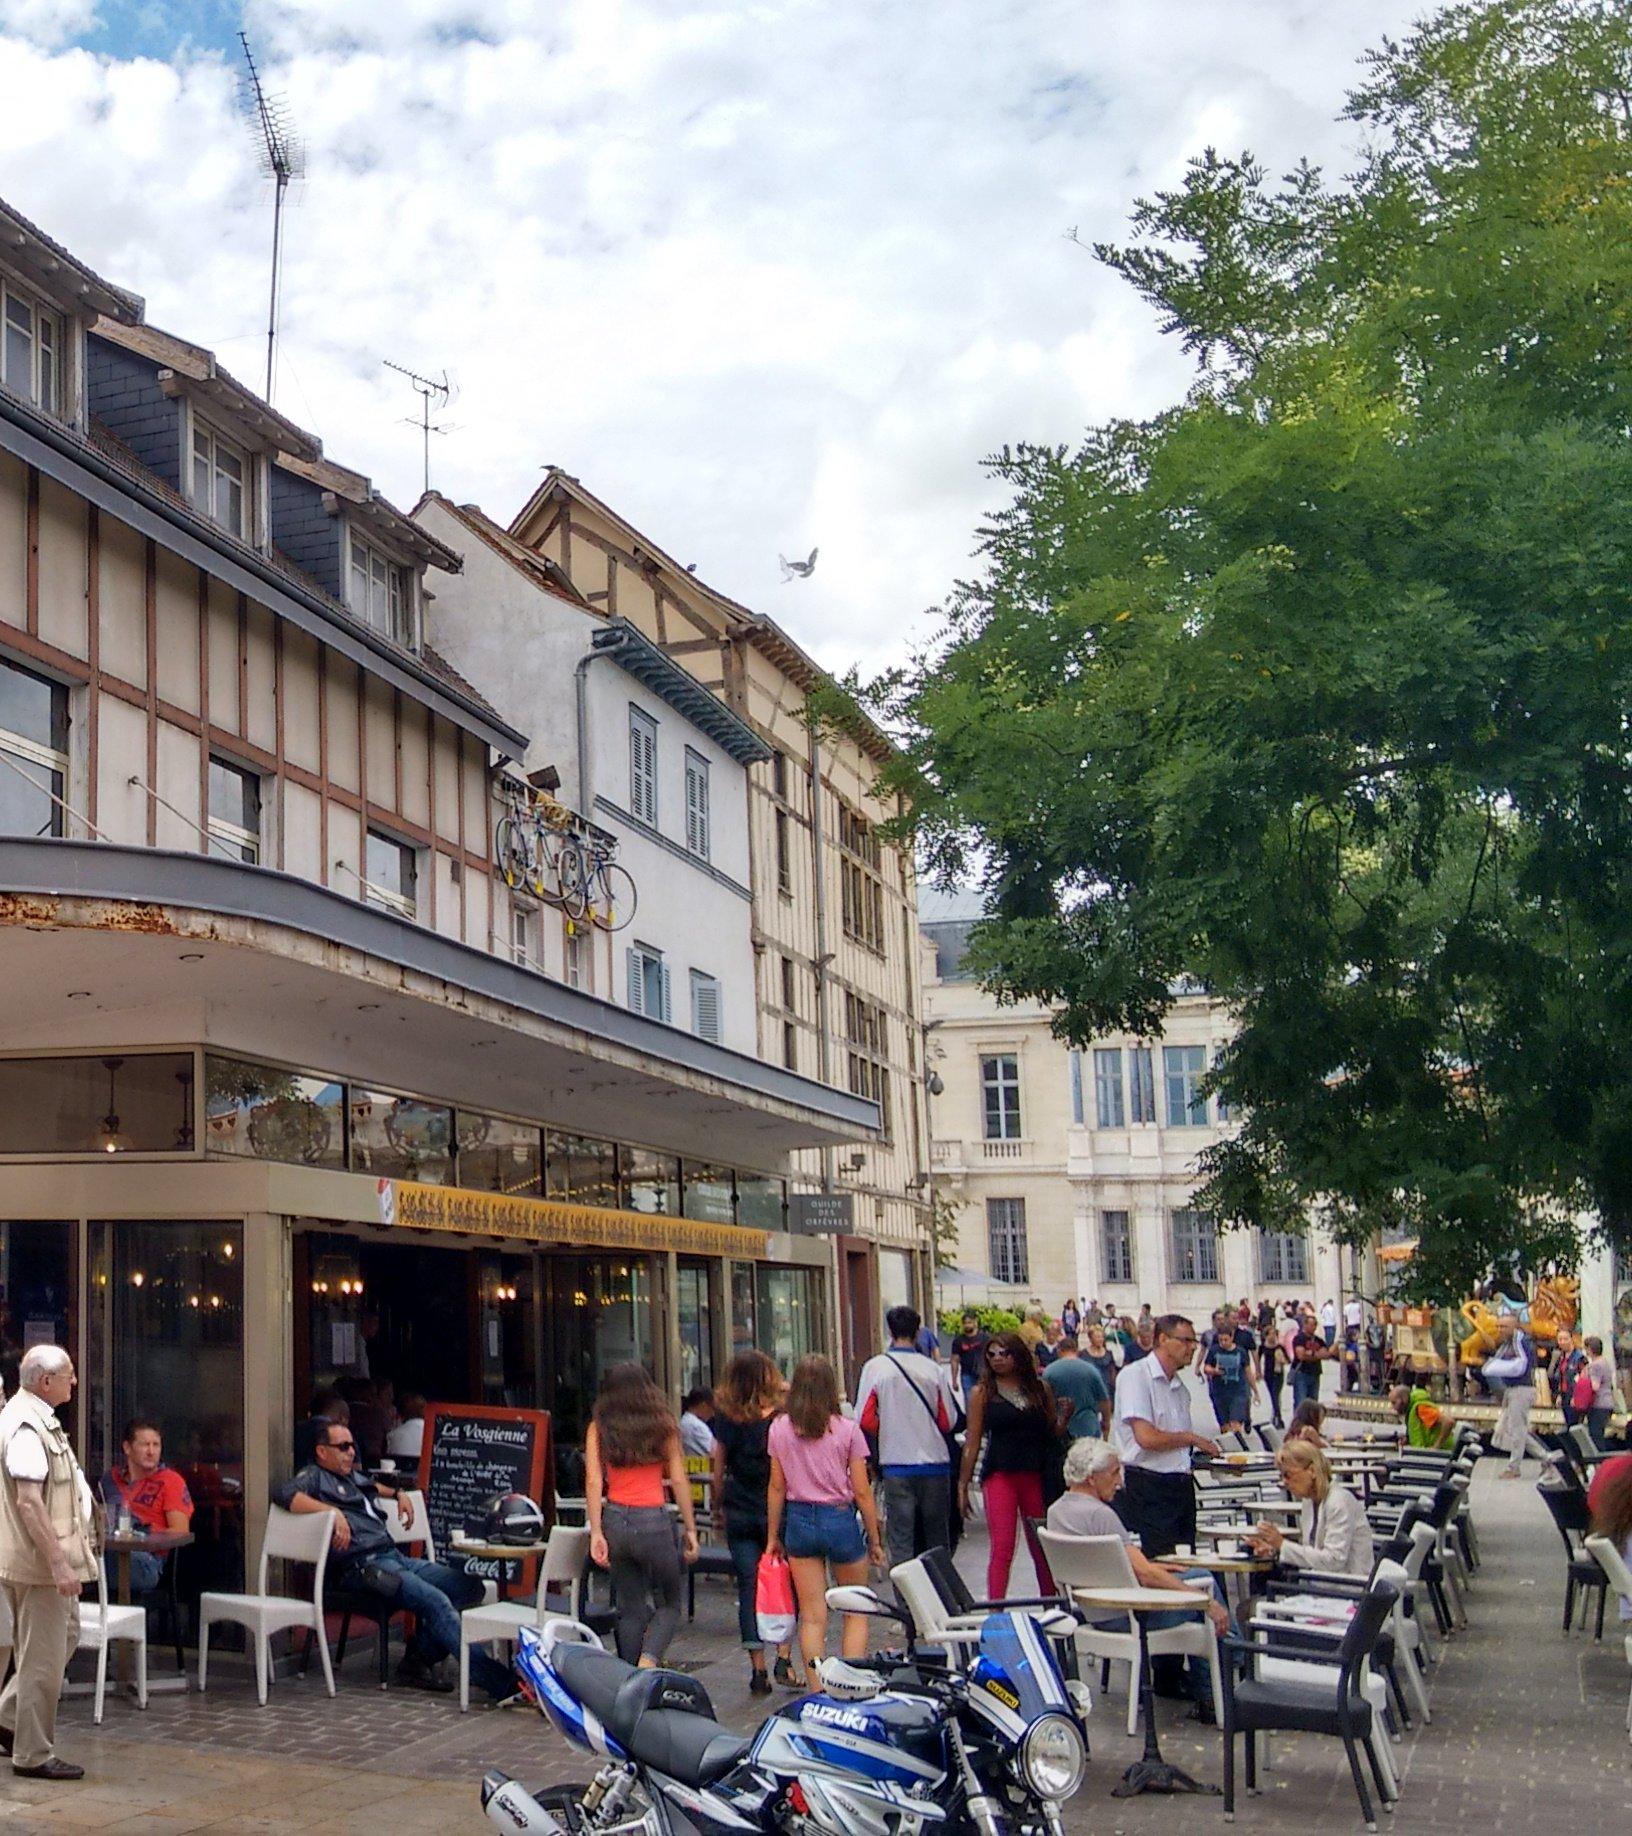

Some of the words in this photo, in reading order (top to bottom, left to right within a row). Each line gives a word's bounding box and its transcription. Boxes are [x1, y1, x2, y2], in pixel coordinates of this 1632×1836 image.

[810, 1200, 842, 1208] GUILDE
[441, 1422, 460, 1437] La
[463, 1422, 529, 1444] Vosgienne
[988, 1681, 1018, 1707] SUZUKI
[803, 1702, 869, 1733] SUZUKI
